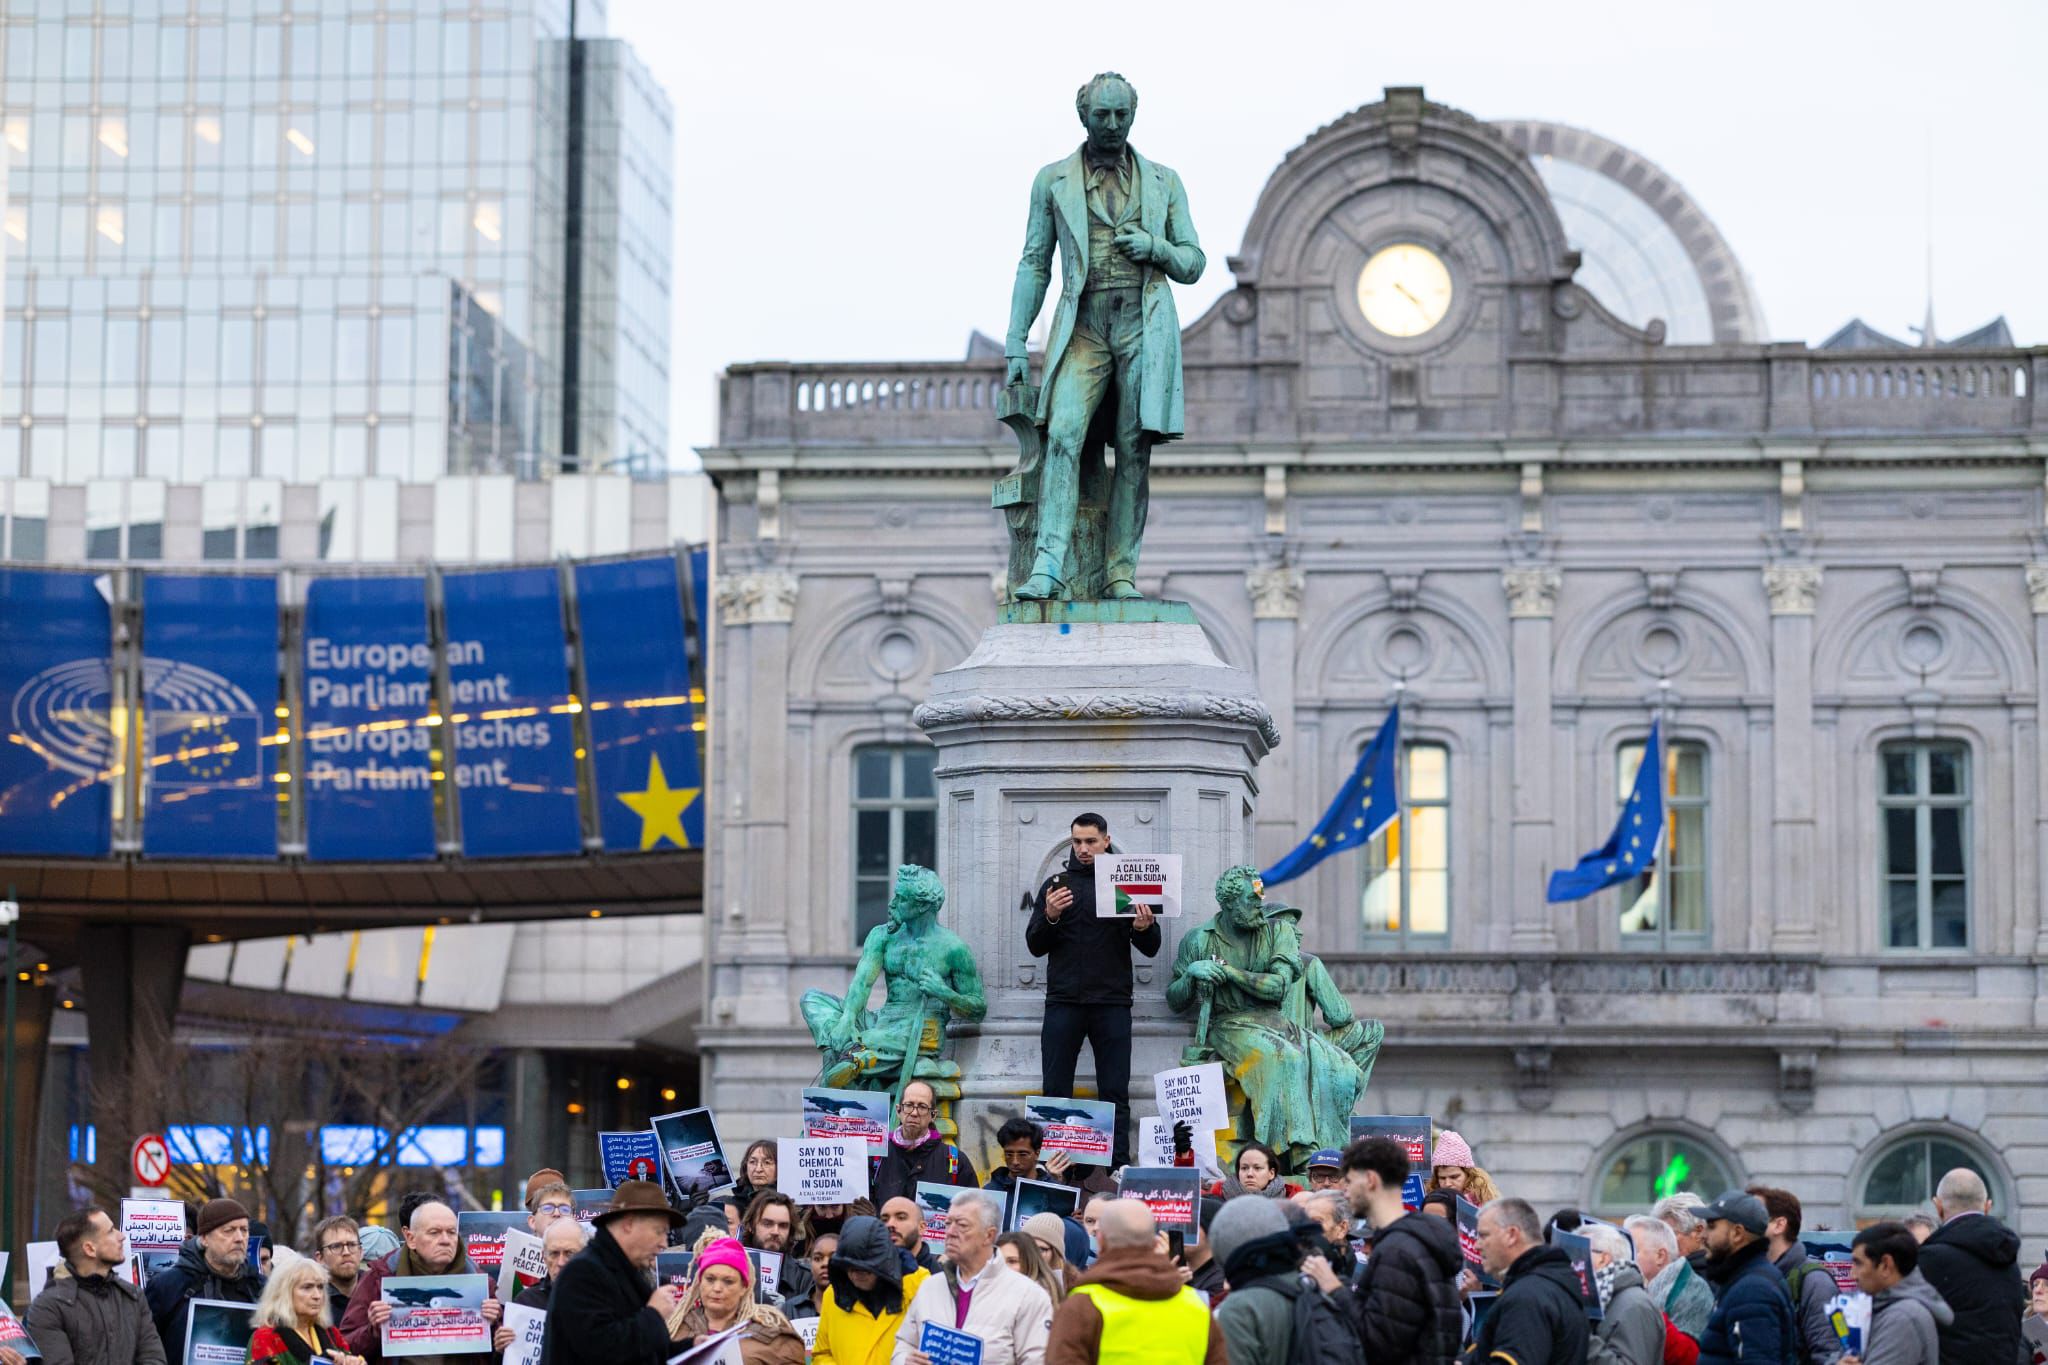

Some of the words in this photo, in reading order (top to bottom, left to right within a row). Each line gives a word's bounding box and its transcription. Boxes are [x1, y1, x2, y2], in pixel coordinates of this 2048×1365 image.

[307, 638, 485, 675] European
[308, 674, 511, 708] Parliament
[311, 759, 511, 791] Parlament
[1116, 864, 1121, 873] A
[1124, 864, 1143, 873] CALL
[1145, 864, 1160, 872] FOR
[1110, 874, 1133, 882] PEACE
[1135, 874, 1142, 882] IN
[1143, 874, 1167, 882] SUDAN
[1164, 1078, 1176, 1088] SAY
[1177, 1076, 1188, 1086] NO
[1190, 1074, 1200, 1084] TO
[1166, 1086, 1202, 1100] CHEMICAL
[1172, 1097, 1195, 1109] DEATH
[1176, 1107, 1202, 1118] SUDAN
[799, 1147, 815, 1157] SAY
[818, 1147, 830, 1156] NO
[833, 1146, 844, 1156] TO
[799, 1158, 844, 1167] CHEMICAL
[1158, 1156, 1166, 1165] IN
[809, 1169, 836, 1178] DEATH
[802, 1180, 810, 1188] IN
[813, 1179, 843, 1188] SUDAN
[520, 1248, 526, 1257] A
[528, 1250, 544, 1264] CAL
[513, 1257, 536, 1272] PEACE
[537, 1265, 547, 1275] IN
[528, 1319, 543, 1331] SA
